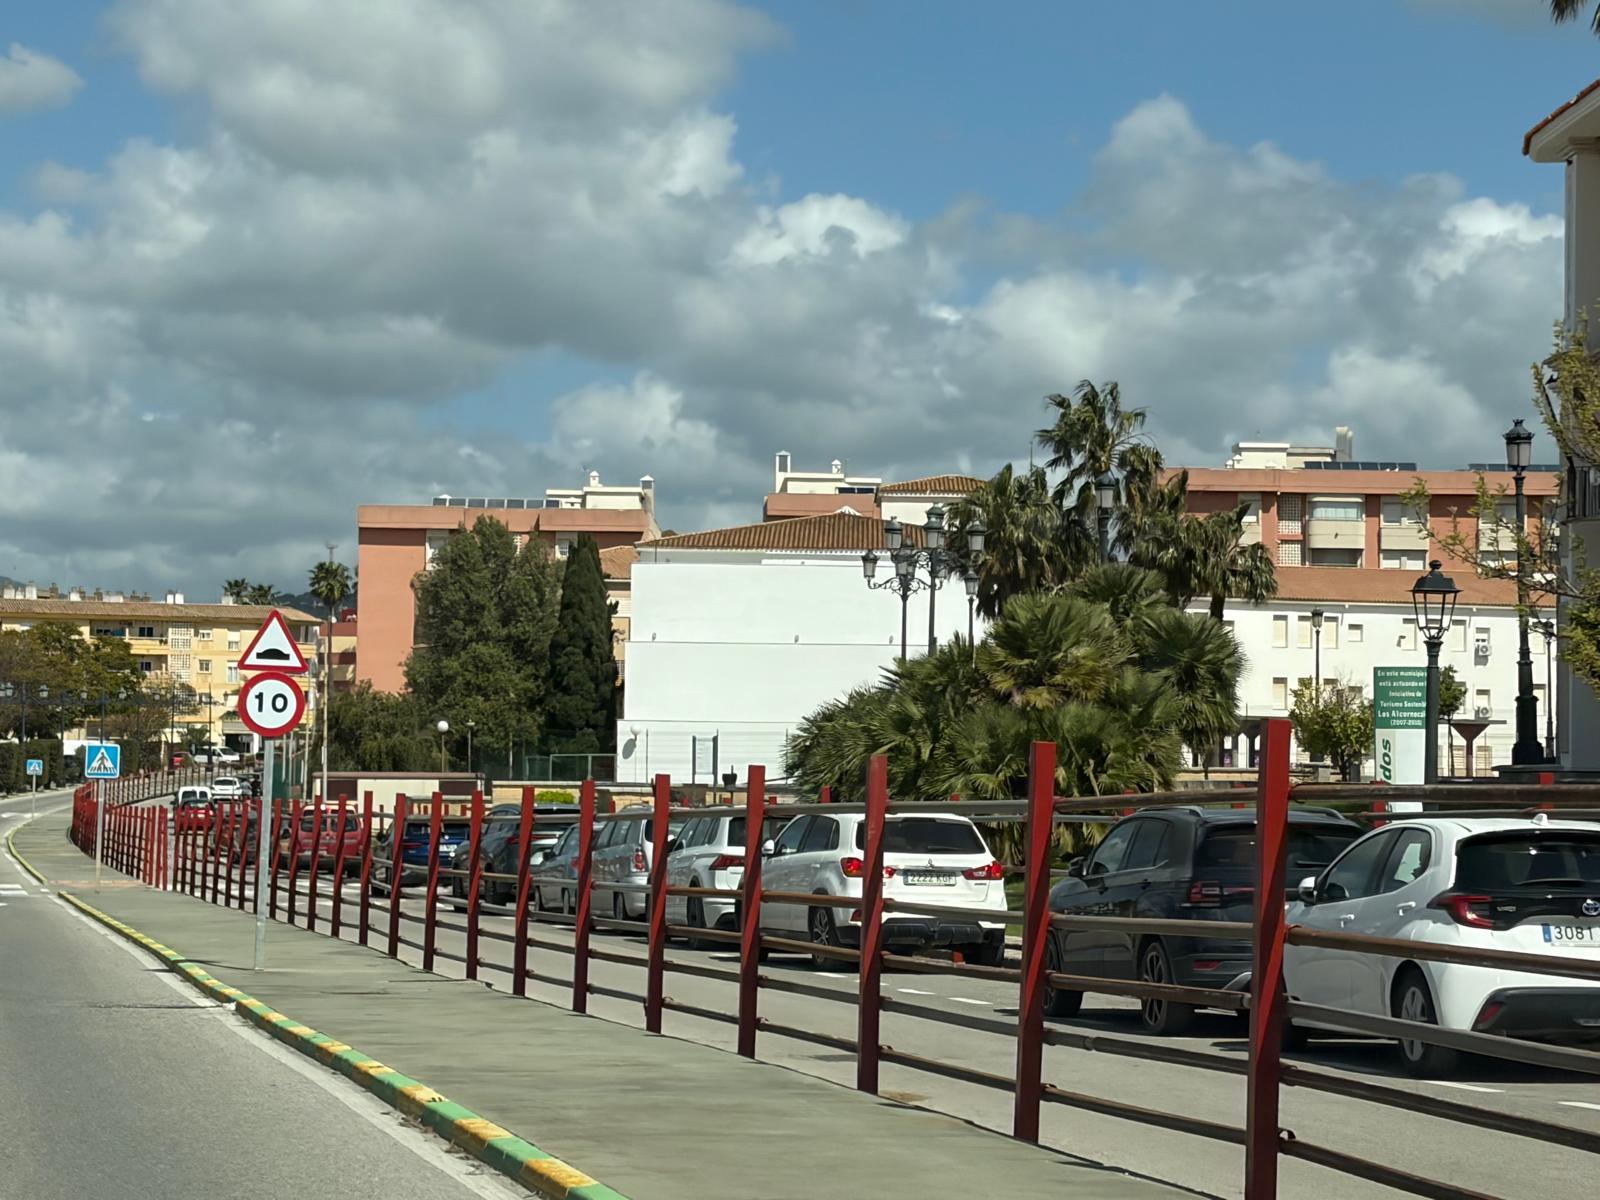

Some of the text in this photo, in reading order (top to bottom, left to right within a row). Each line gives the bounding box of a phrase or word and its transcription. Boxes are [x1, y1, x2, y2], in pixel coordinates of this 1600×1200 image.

[254, 691, 288, 713] 10
[1380, 700, 1403, 708] Turismo
[1377, 710, 1390, 718] Los
[1554, 926, 1594, 940] 3081
